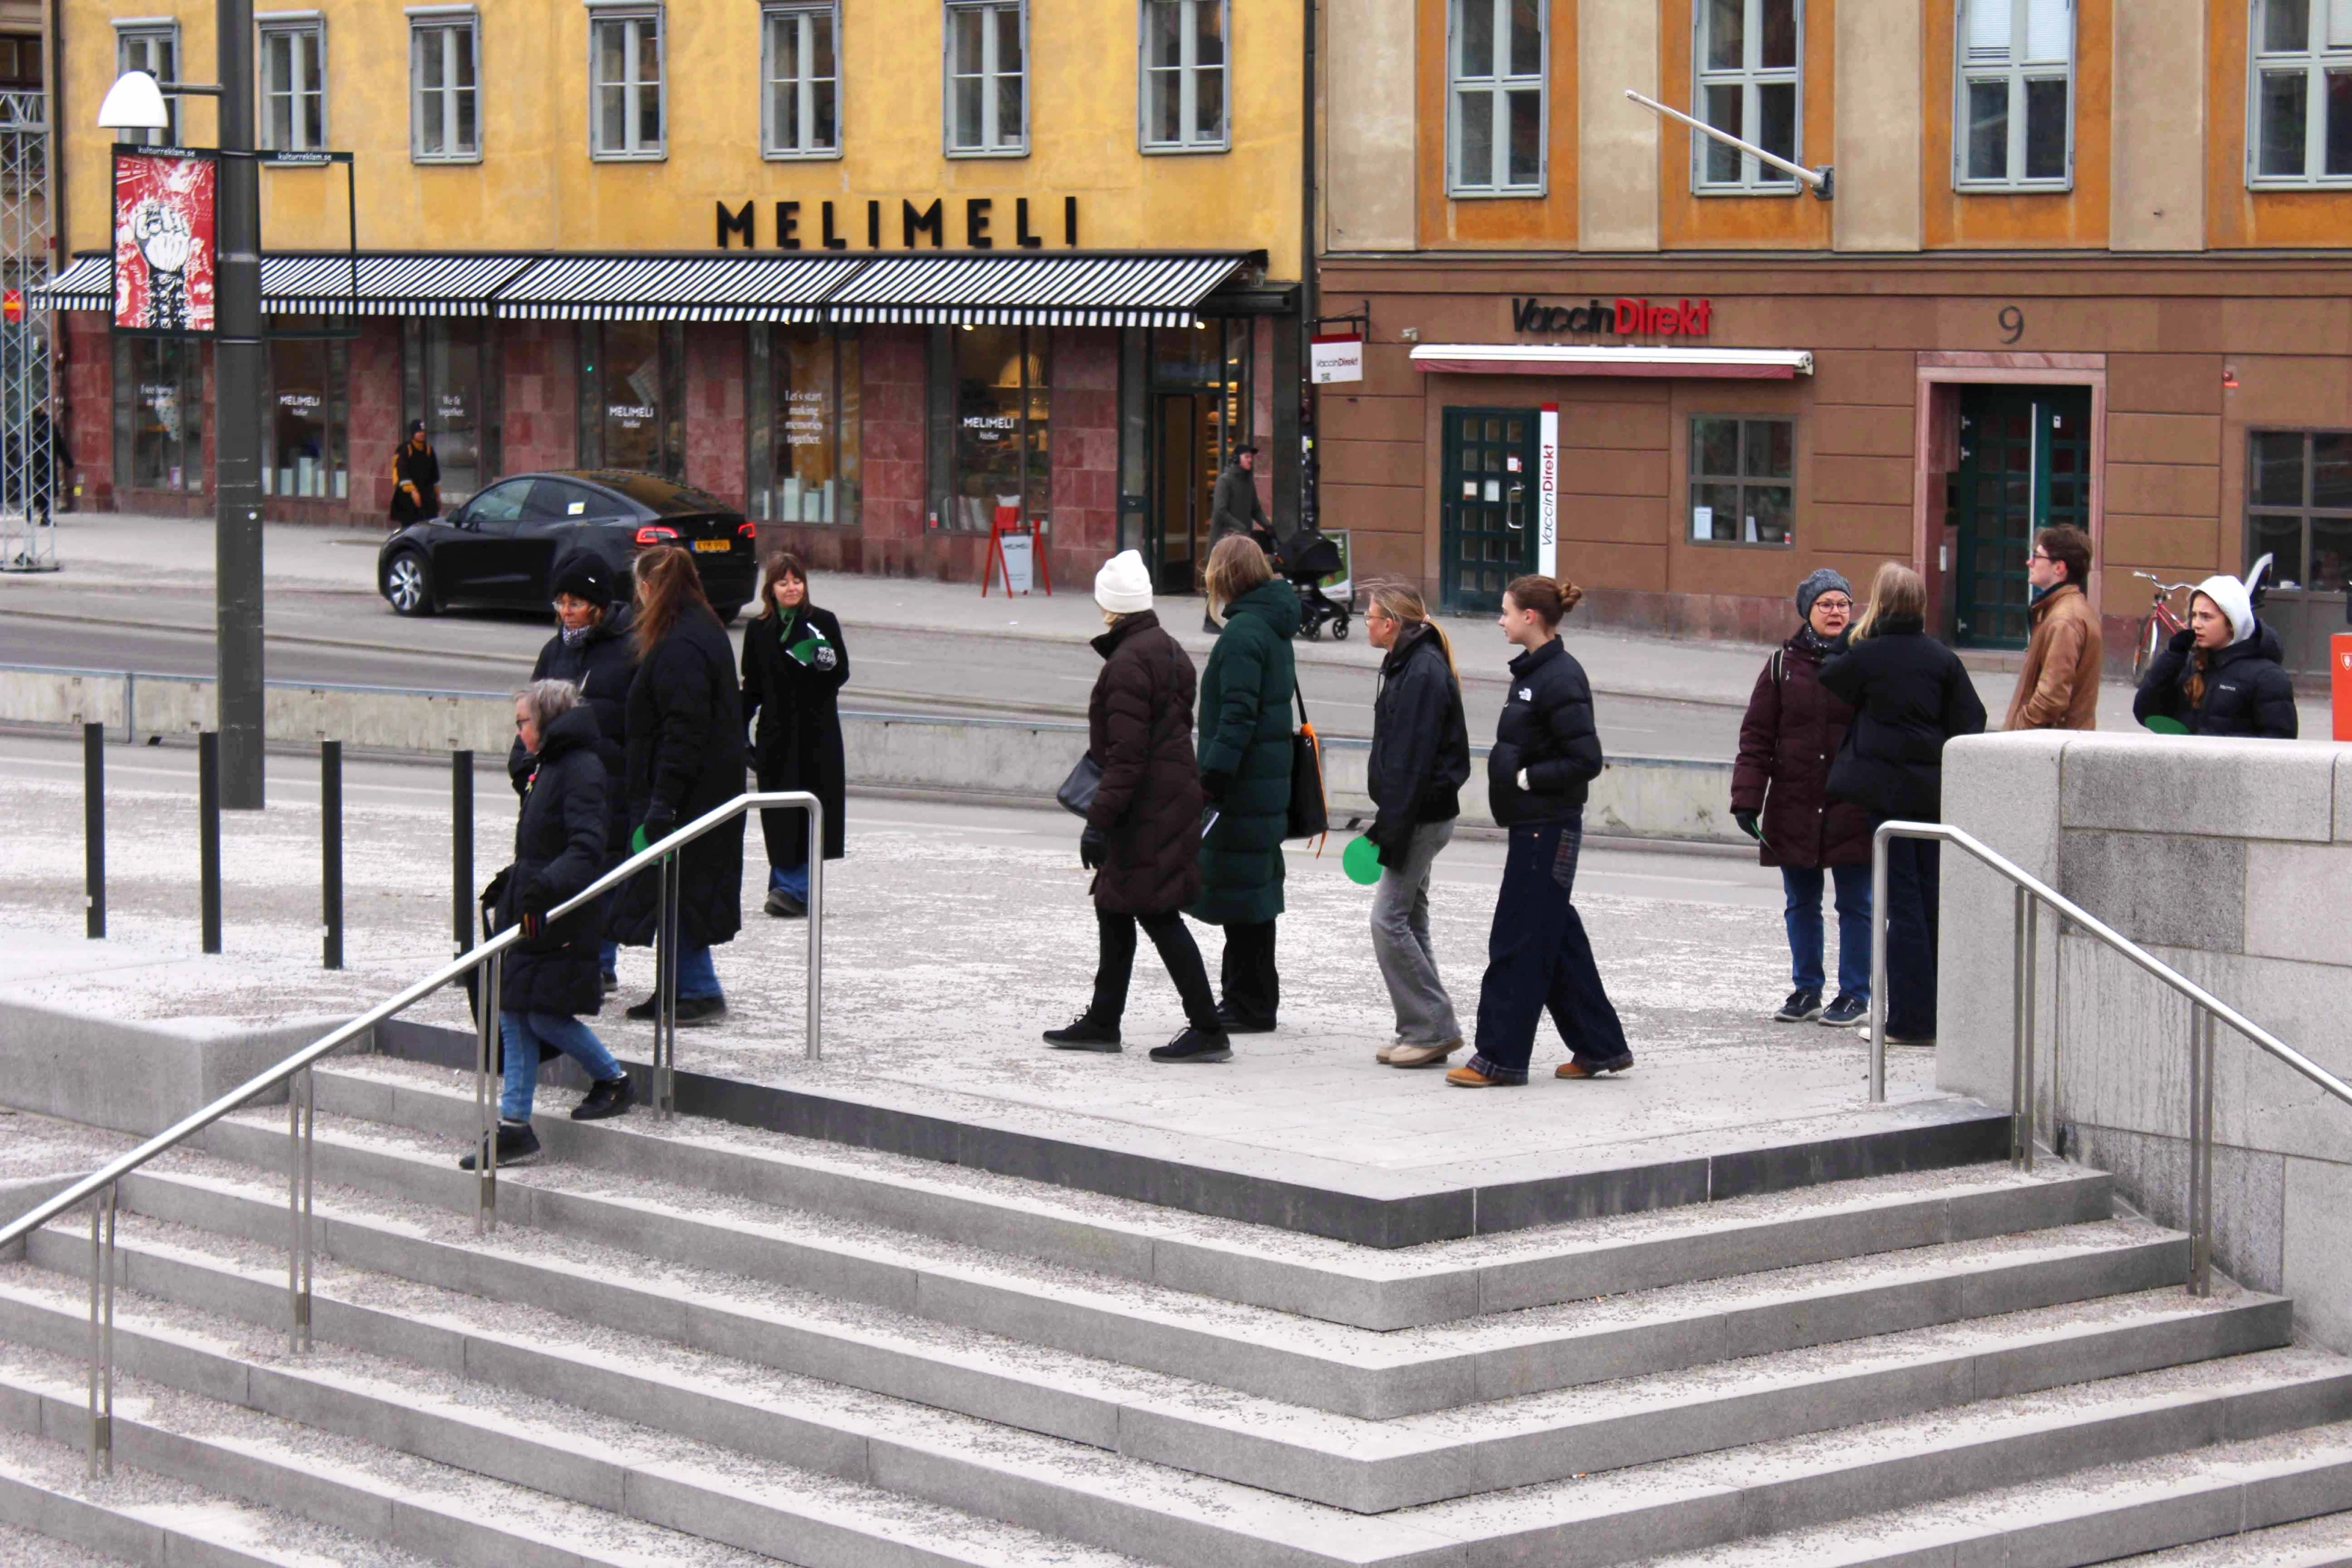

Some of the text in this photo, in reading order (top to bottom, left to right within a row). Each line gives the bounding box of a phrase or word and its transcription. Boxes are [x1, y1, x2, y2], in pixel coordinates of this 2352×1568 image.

[137, 145, 196, 157] kulturreklam.se
[278, 151, 332, 162] kulturreklam.se
[716, 196, 1077, 250] MELIMELI
[1511, 297, 1712, 336] VaccinDirekt
[1998, 305, 2024, 345] 9
[280, 395, 321, 406] MELIMELI
[609, 406, 654, 418] MELIMELI
[963, 417, 1014, 429] MELIMELI
[1542, 444, 1554, 546] VaccinDirekt
